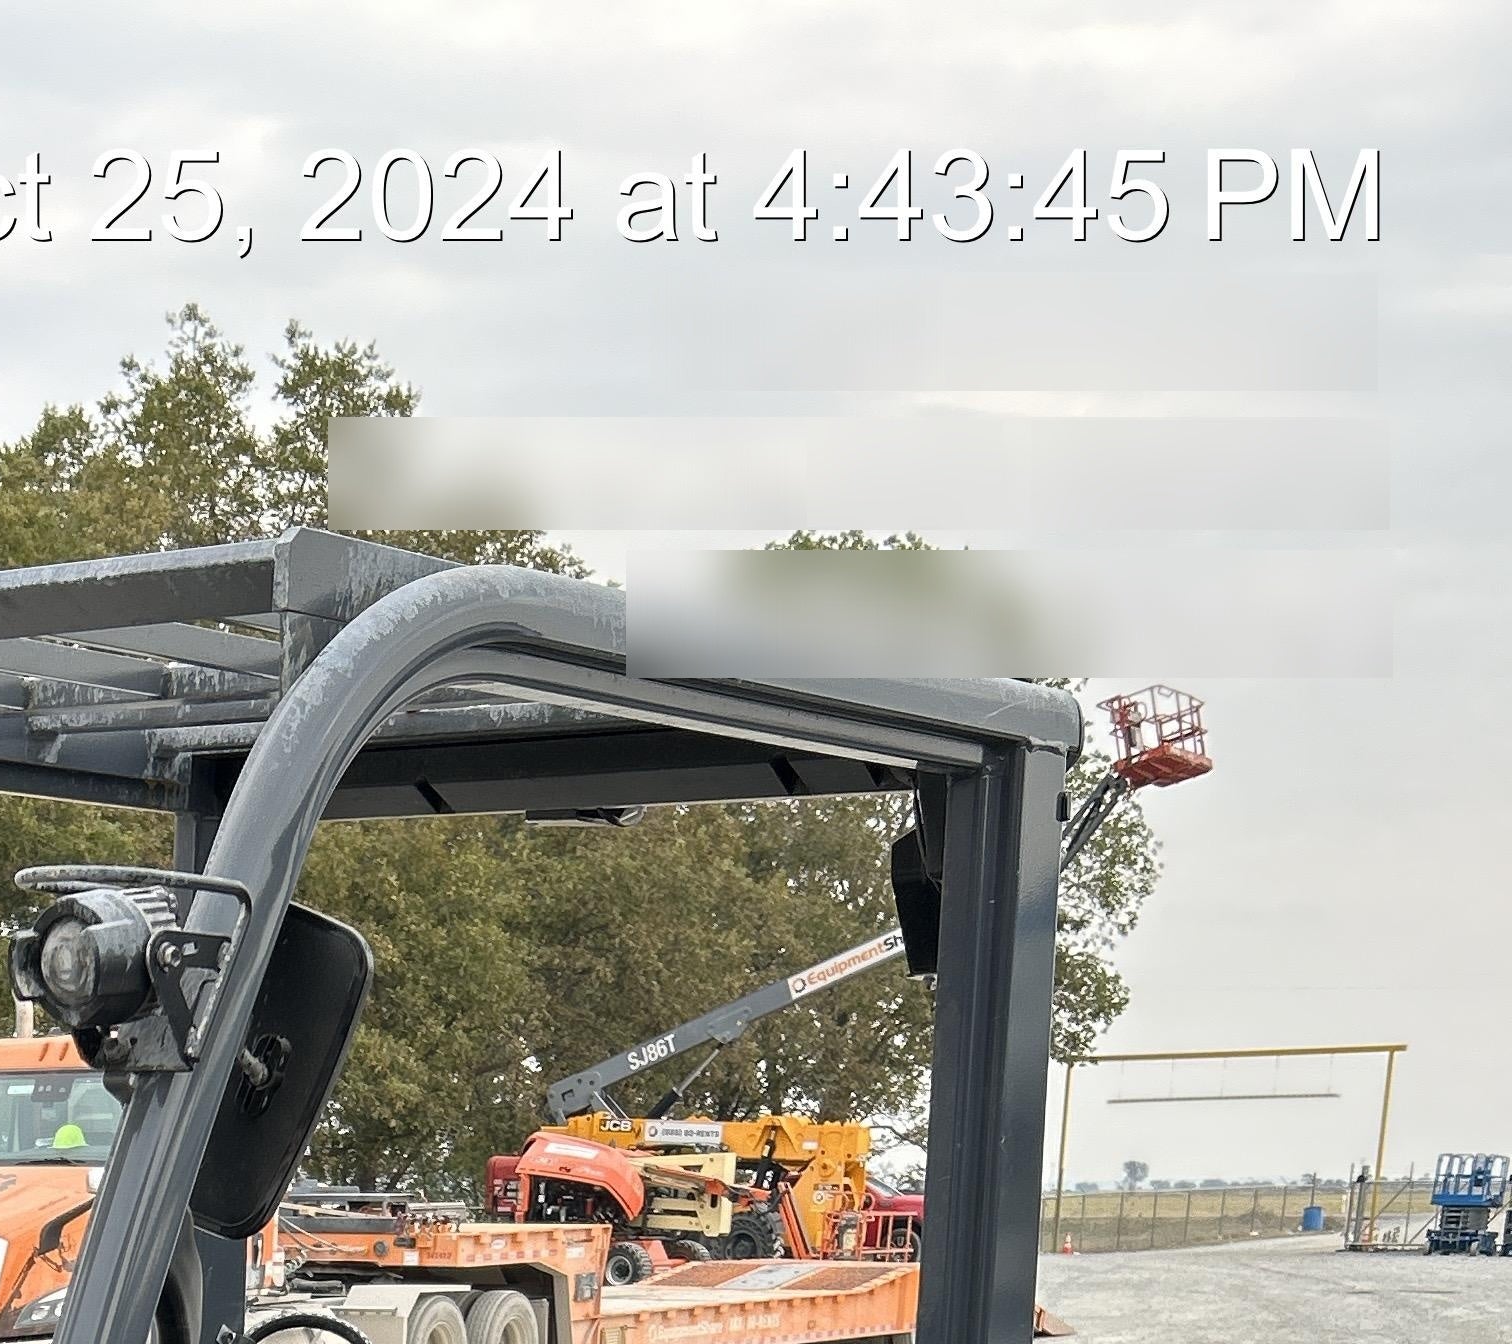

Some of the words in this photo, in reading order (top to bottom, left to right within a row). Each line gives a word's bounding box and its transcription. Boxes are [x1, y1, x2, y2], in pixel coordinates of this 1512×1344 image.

[807, 934, 904, 985] EquipmentSh
[627, 1033, 677, 1071] SJ86T
[600, 1120, 632, 1132] JCB
